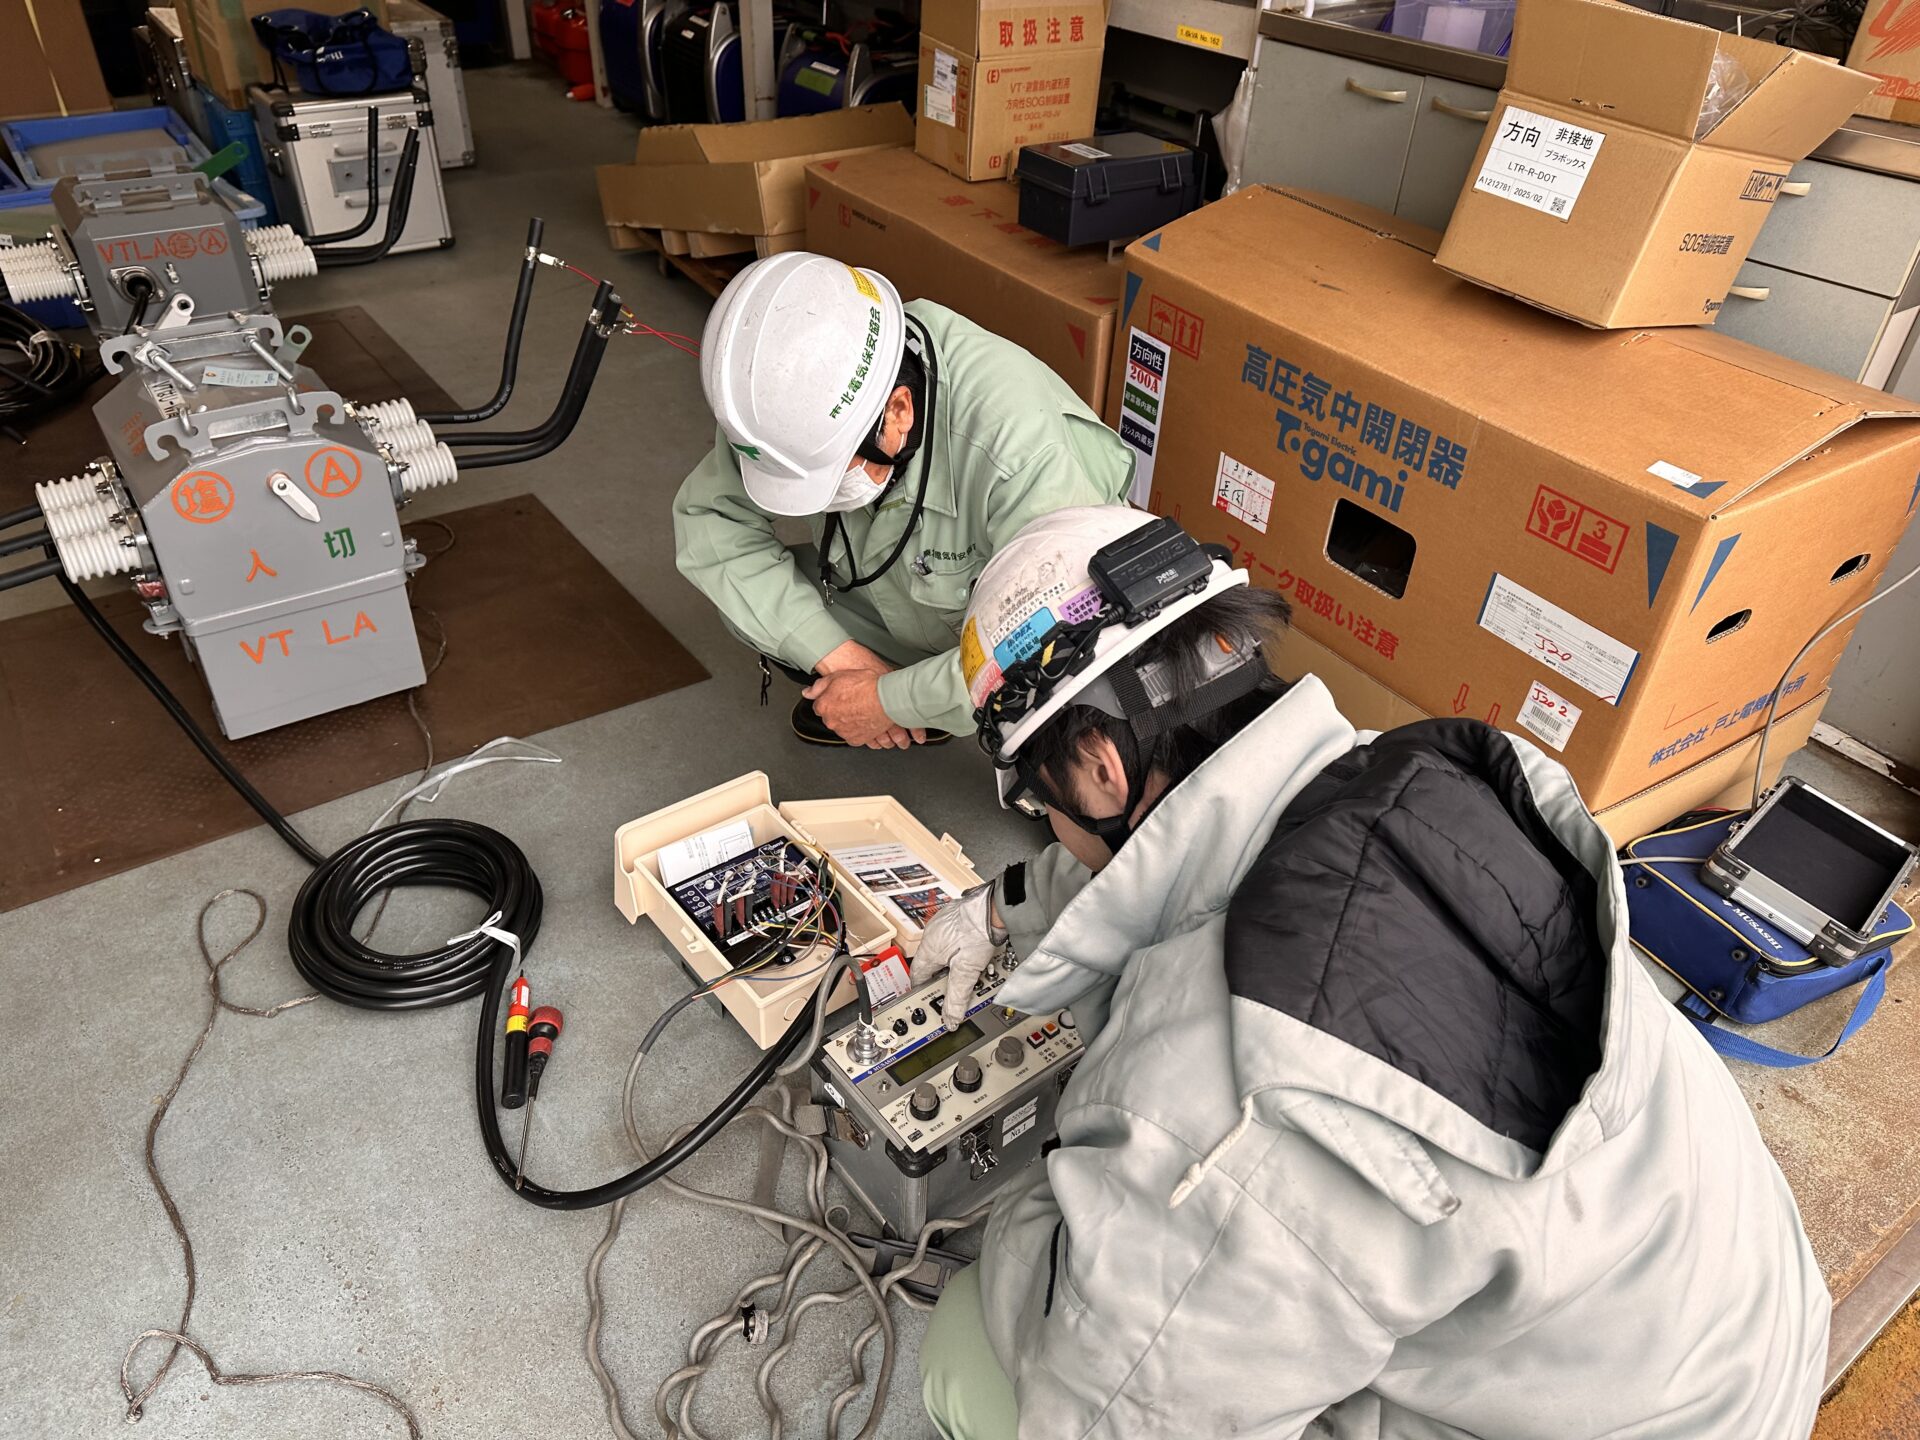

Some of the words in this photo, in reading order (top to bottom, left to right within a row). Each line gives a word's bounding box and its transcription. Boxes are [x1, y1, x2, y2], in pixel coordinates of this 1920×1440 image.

[1000, 16, 1085, 48] 取扱注意
[1503, 121, 1541, 148] 方向
[1555, 127, 1594, 150] 非接地
[1507, 161, 1557, 184] LTR-R-DOT
[1478, 175, 1512, 193] A1212781
[1513, 187, 1543, 204] 2025/02
[1679, 233, 1735, 255] SOG制御装置
[1132, 341, 1163, 372] 方向性
[1129, 365, 1159, 394] 200A
[1241, 343, 1468, 490] 高圧気中開閉器
[1303, 422, 1331, 443] Togami
[1330, 435, 1358, 457] Electric
[1275, 408, 1408, 513] Togami
[323, 527, 357, 560] 切
[1227, 534, 1400, 661] フォーク取扱い注意
[239, 628, 295, 665] VT
[321, 611, 378, 645] LA
[1558, 705, 1568, 717] 2
[1649, 725, 1710, 768] 株式会社
[1710, 673, 1809, 736] 戸上電機作所
[1732, 908, 1783, 950] MUSASHI
[873, 1056, 897, 1072] MUSASHI
